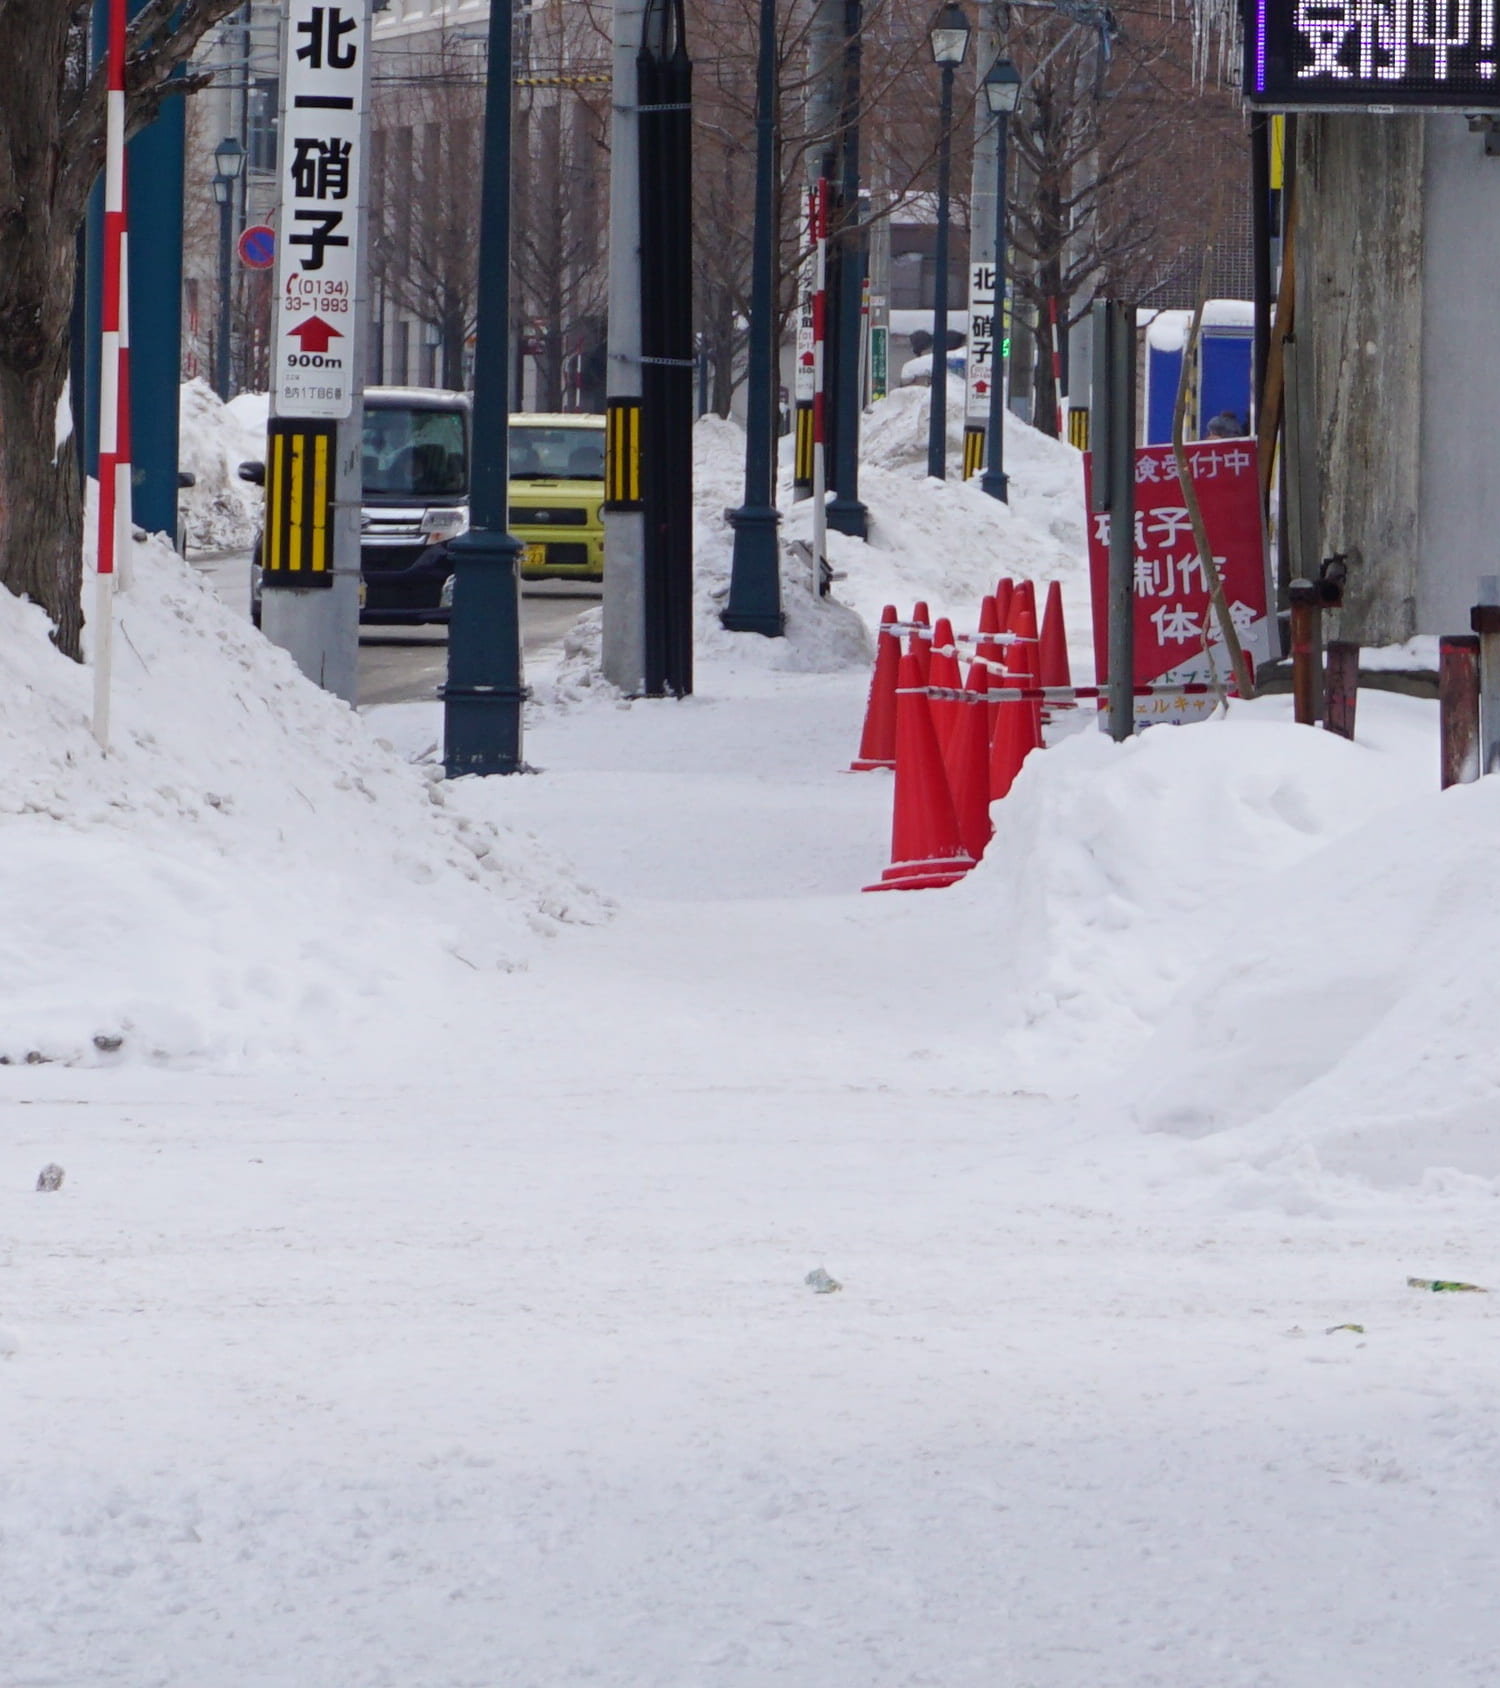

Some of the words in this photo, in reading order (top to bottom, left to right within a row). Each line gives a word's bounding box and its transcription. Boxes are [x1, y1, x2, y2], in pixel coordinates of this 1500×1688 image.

[289, 6, 357, 271] 北一硝子
[298, 278, 349, 297] (0134)
[285, 296, 349, 312] 33-1993
[971, 267, 996, 364] 北一硝子
[287, 354, 342, 368] 900m
